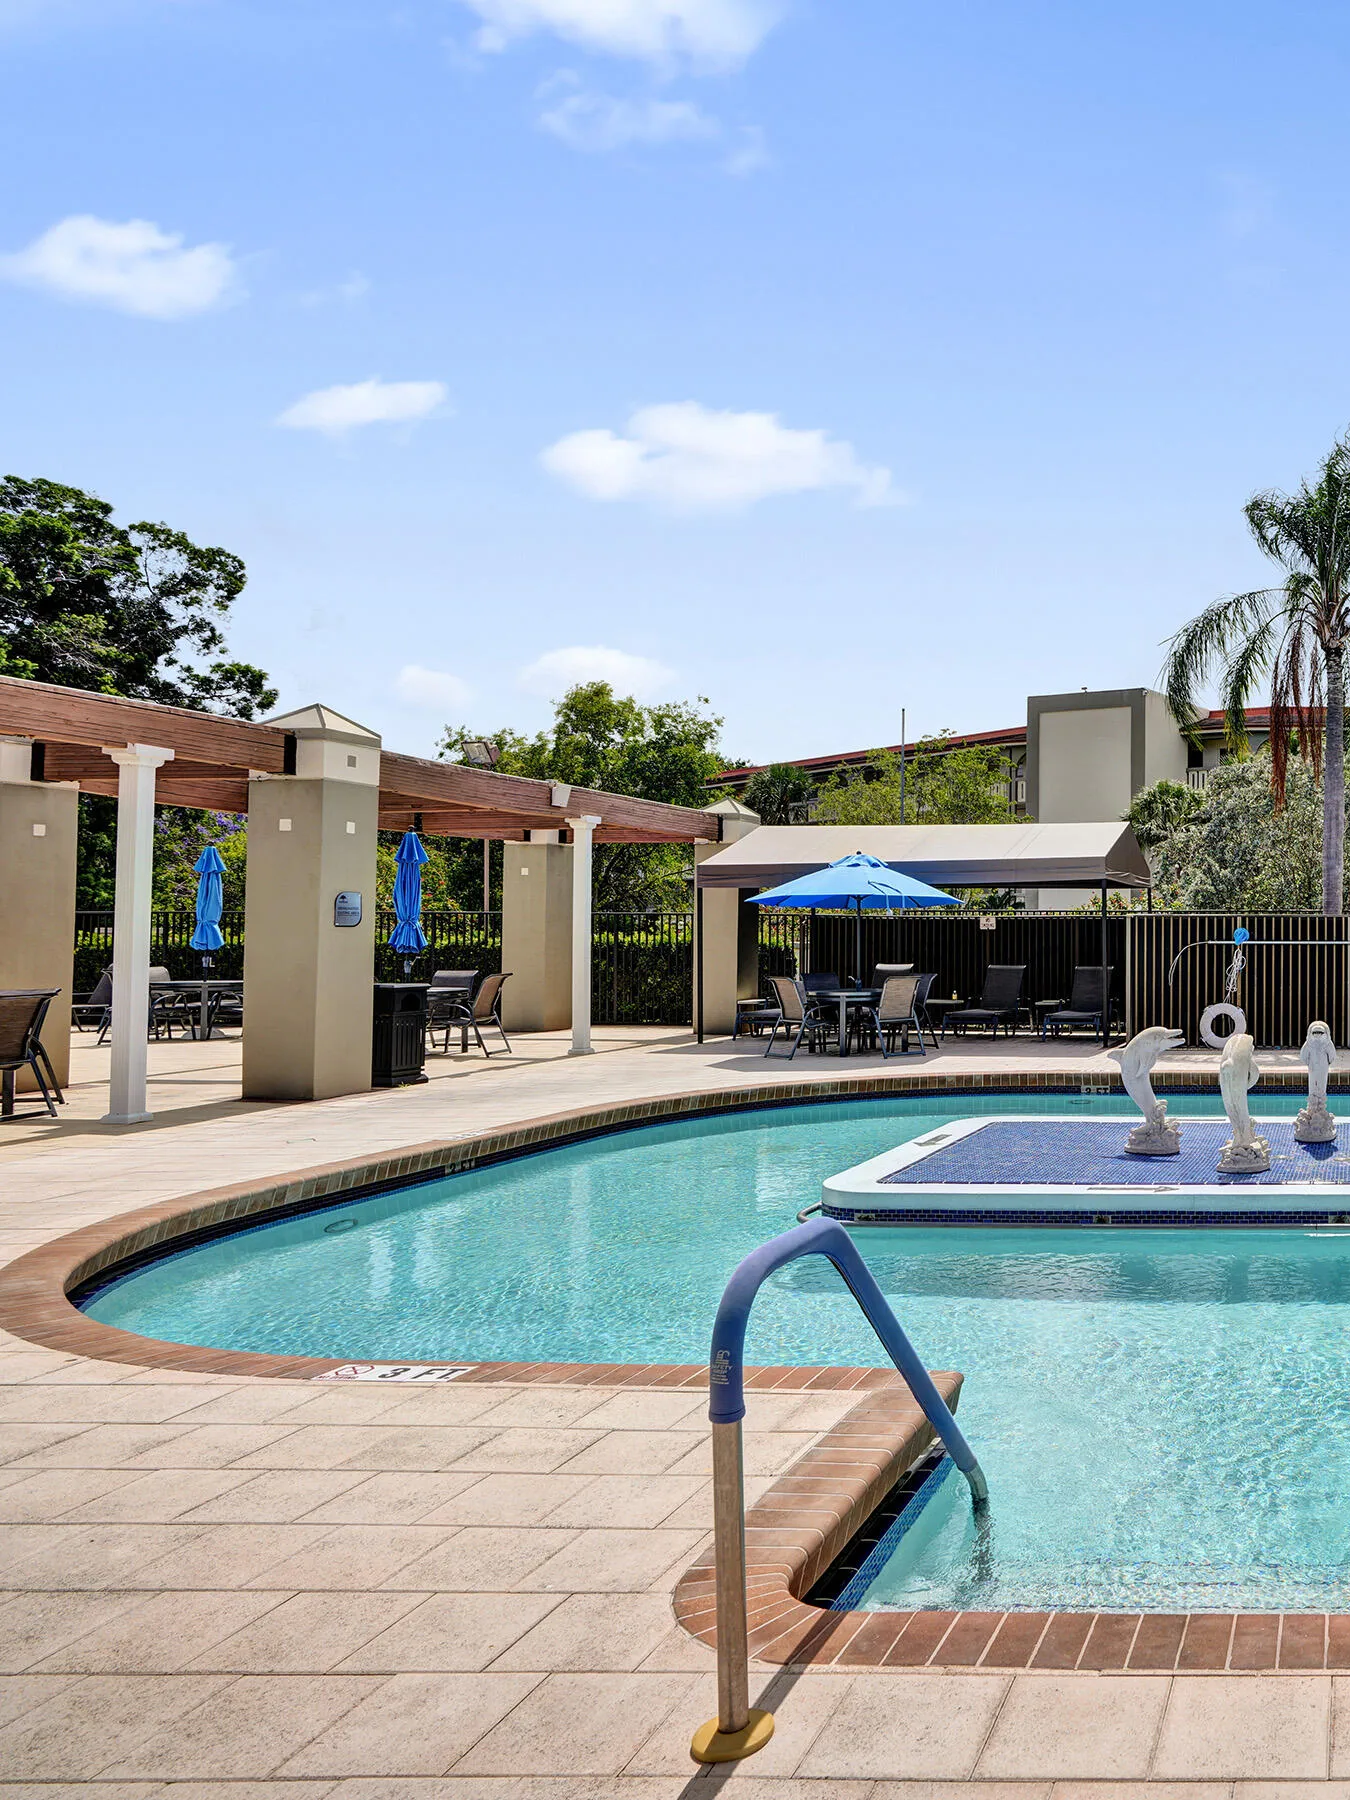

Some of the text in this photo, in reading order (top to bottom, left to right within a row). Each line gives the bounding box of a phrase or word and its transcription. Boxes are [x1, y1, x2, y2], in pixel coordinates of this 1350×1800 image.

[461, 1158, 474, 1171] FT
[378, 1368, 468, 1379] 3 FT.
